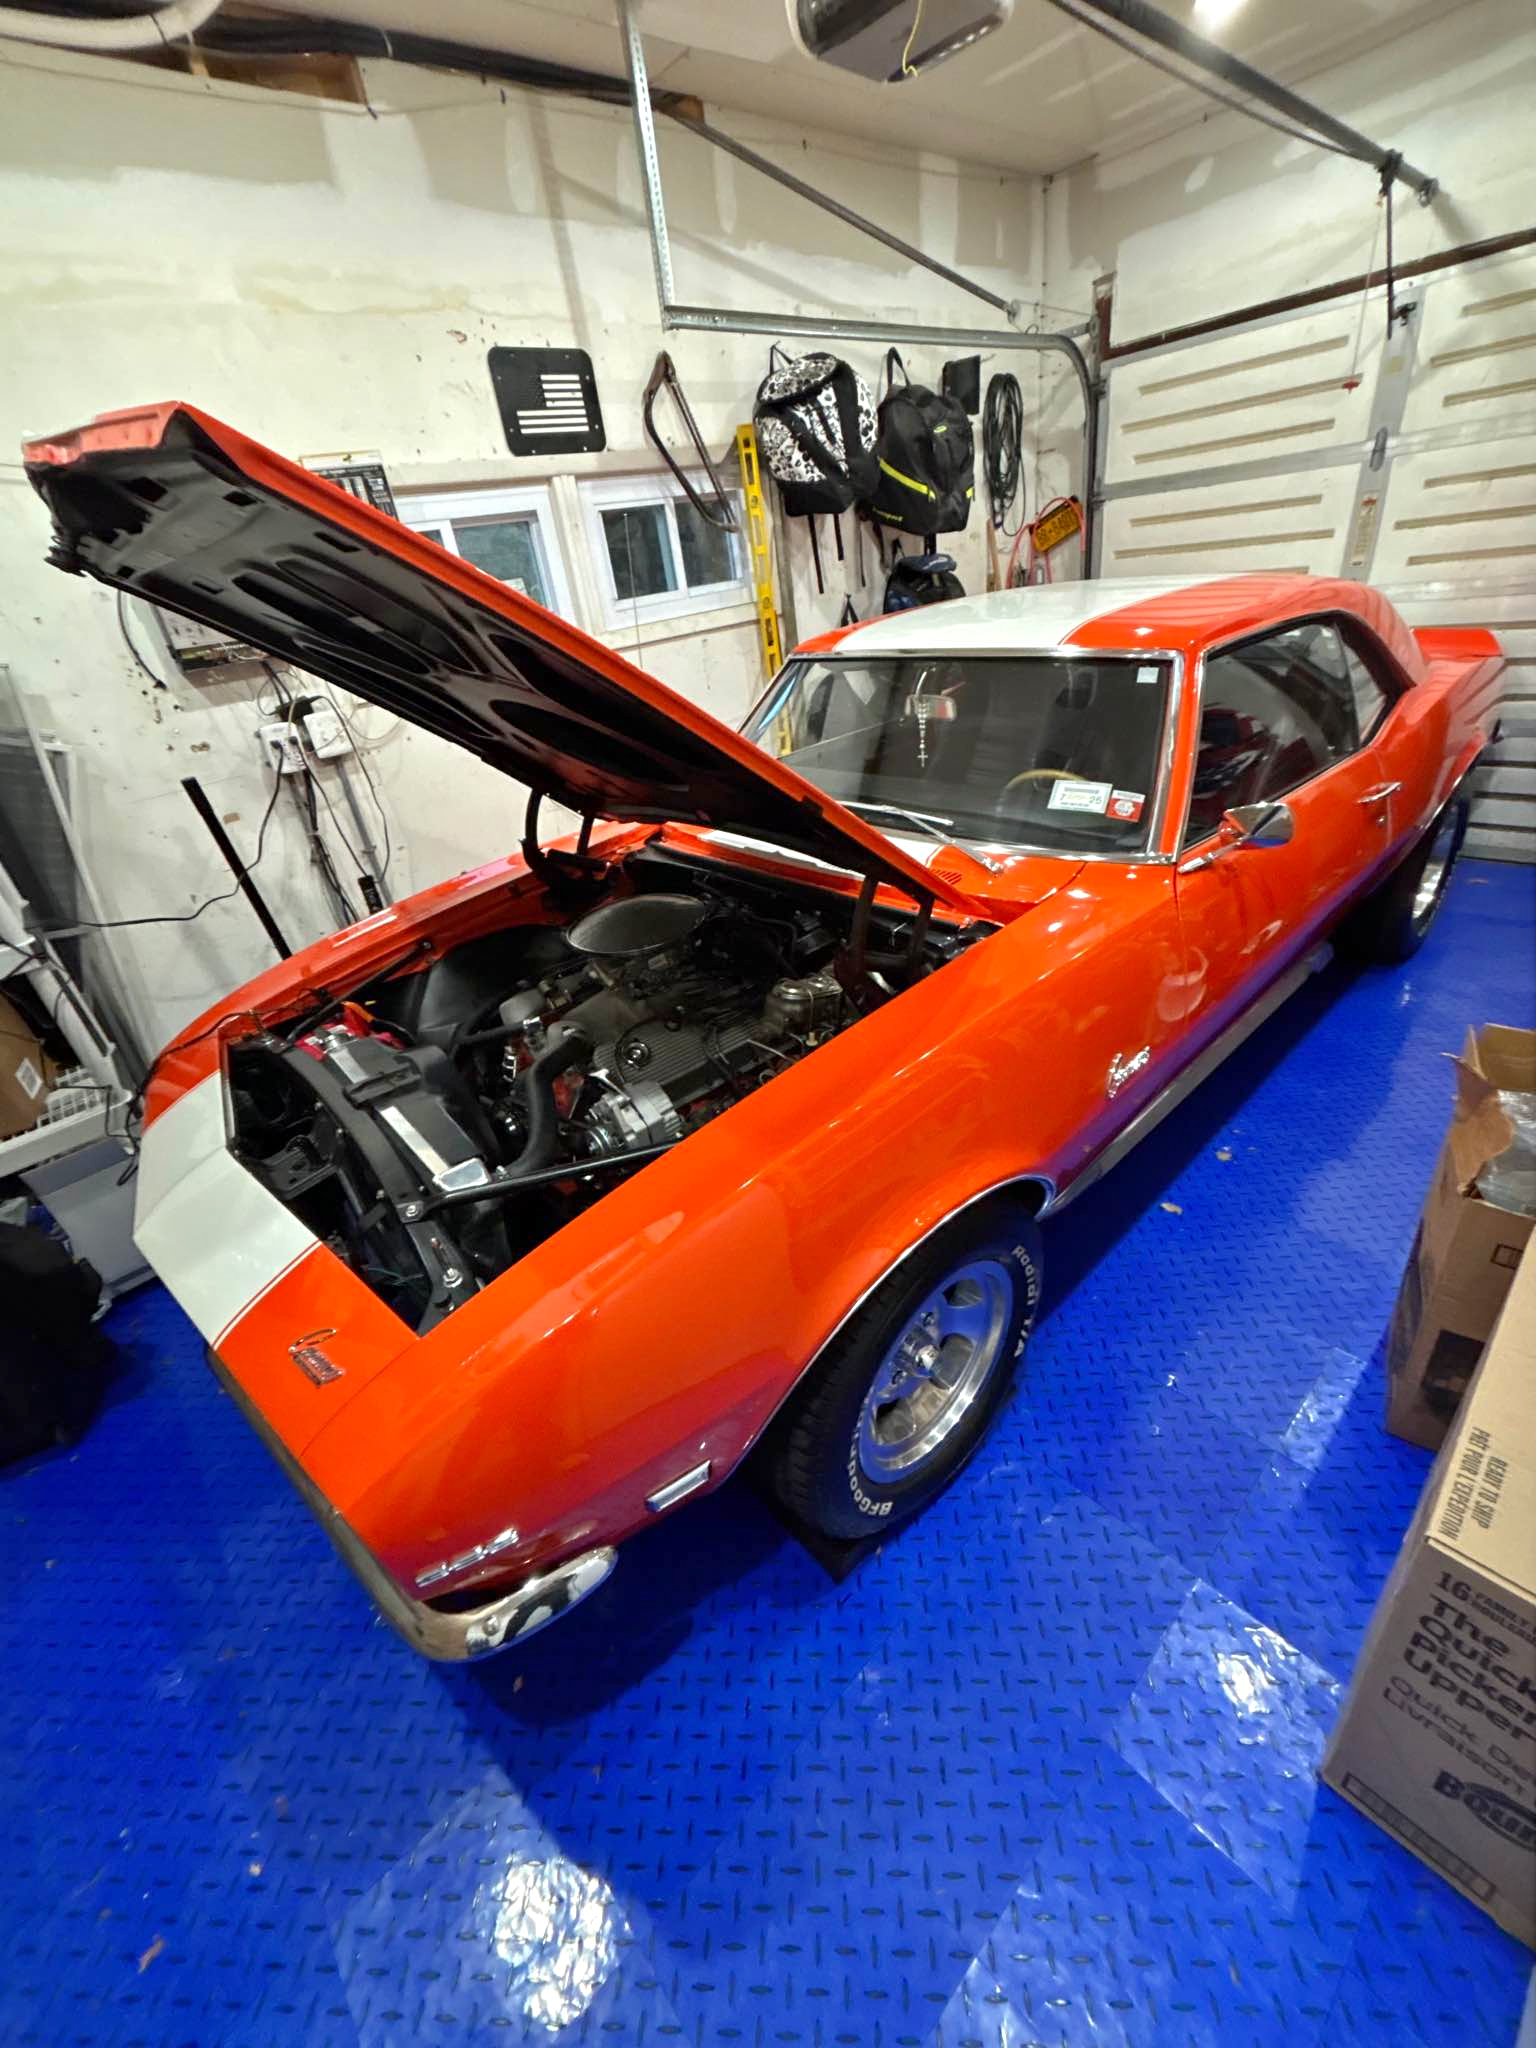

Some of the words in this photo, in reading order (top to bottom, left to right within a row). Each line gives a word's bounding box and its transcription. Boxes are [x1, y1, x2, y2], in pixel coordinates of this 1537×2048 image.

[1458, 1447, 1484, 1477] POUR
[1486, 1456, 1509, 1491] READY
[1478, 1486, 1501, 1504] TO
[1470, 1500, 1496, 1530] SHIP
[1435, 1570, 1472, 1601] 16
[1429, 1592, 1510, 1658] The
[1390, 1675, 1478, 1743] Quick
[1403, 1648, 1536, 1742] Upper
